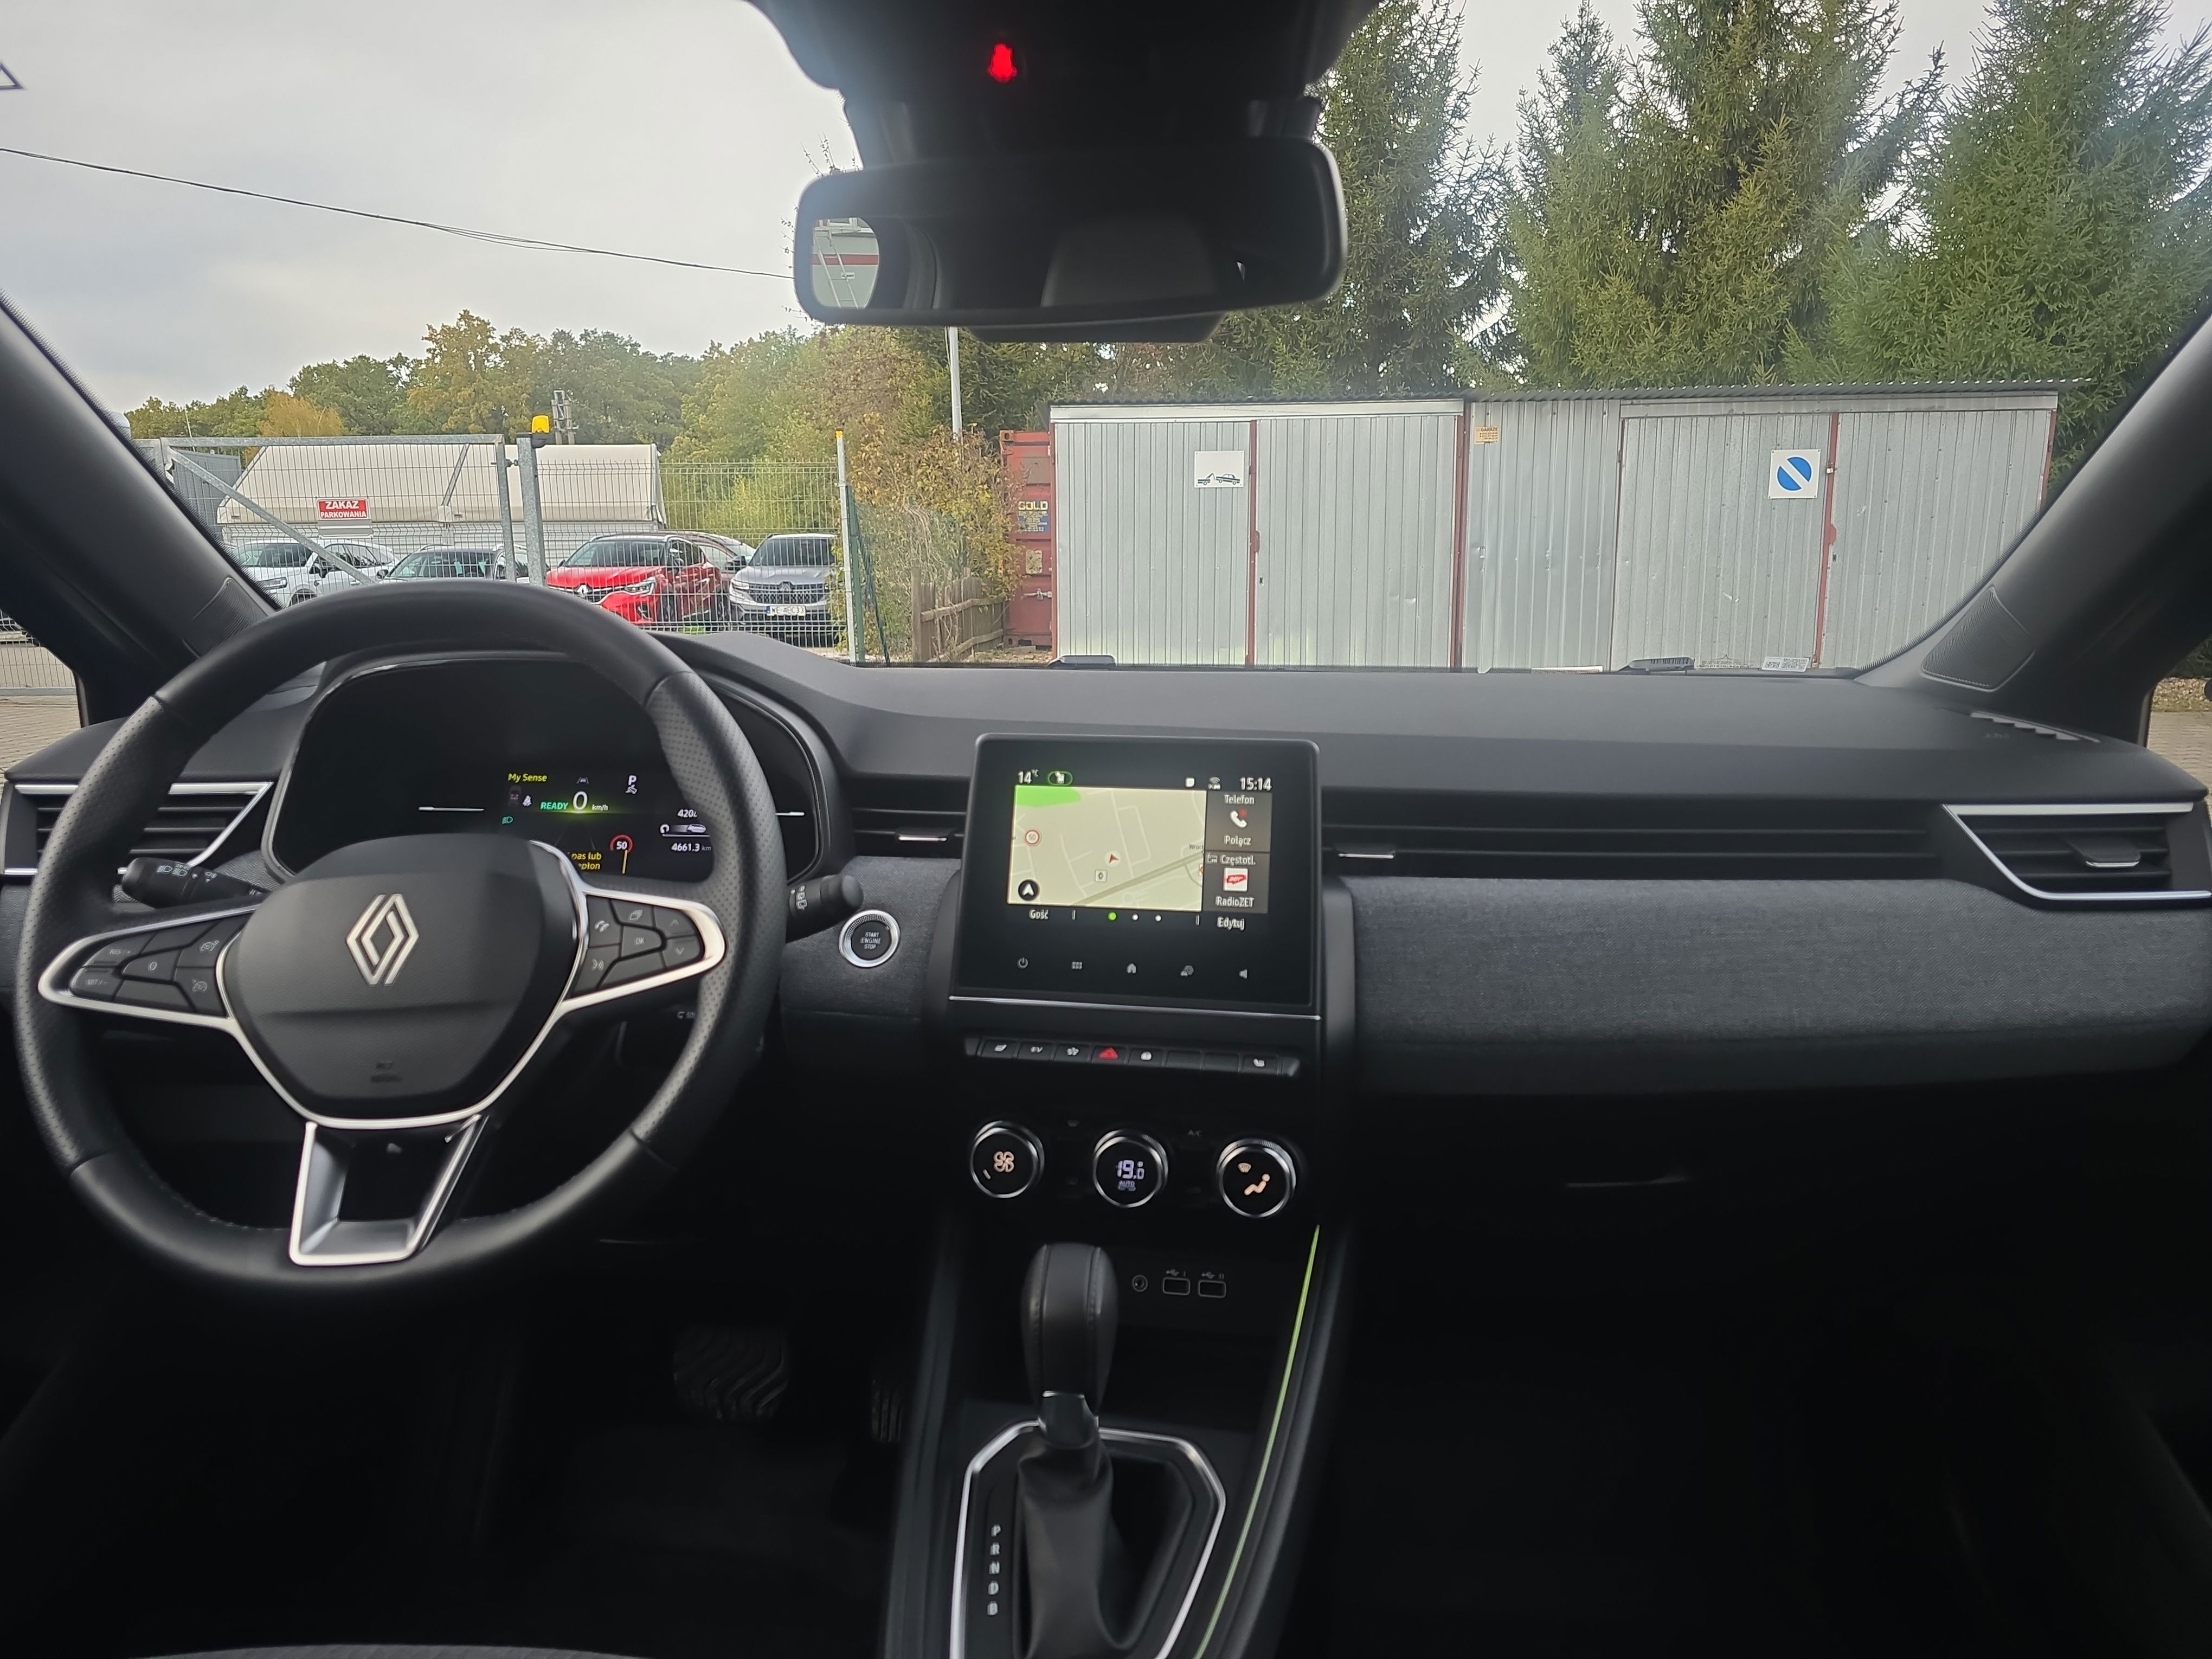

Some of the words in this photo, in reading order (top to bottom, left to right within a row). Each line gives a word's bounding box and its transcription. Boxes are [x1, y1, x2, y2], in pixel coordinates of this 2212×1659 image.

[325, 500, 359, 510] ZAKAZ
[507, 773, 521, 783] My
[522, 774, 547, 782] Sense
[628, 775, 637, 786] P
[1239, 776, 1272, 791] 15:14
[573, 791, 588, 810] 0
[1224, 794, 1255, 805] Telefon
[540, 802, 569, 810] READY
[616, 841, 628, 850] 50
[671, 843, 700, 852] 4661.3
[588, 852, 602, 860] lub
[1216, 896, 1255, 908] RadioZET
[1029, 909, 1049, 919] Gość
[1217, 917, 1245, 931] Edytuj
[991, 1524, 1001, 1536] P
[989, 1542, 1000, 1555] R
[989, 1560, 1000, 1574] N
[988, 1580, 999, 1595] D
